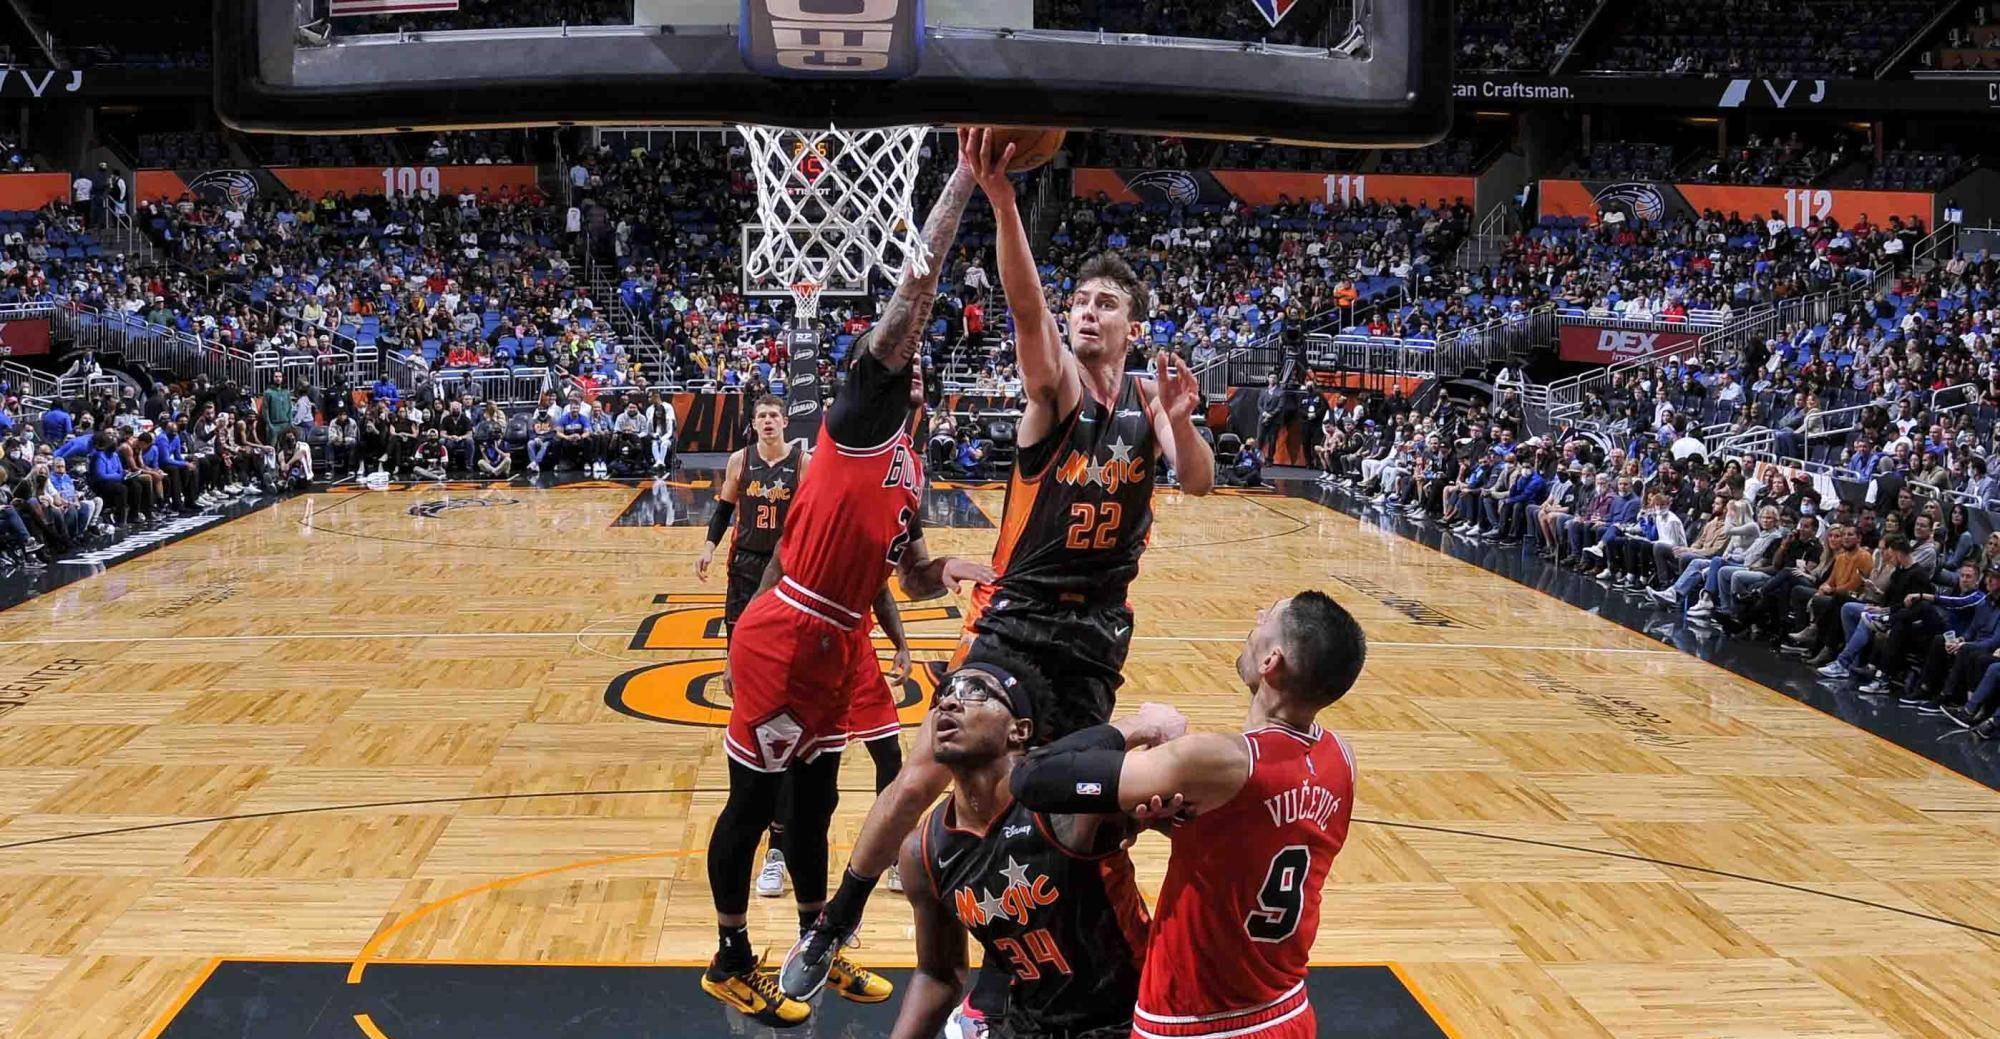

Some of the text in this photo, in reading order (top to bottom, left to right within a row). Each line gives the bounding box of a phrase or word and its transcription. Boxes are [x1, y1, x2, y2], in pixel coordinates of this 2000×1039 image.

[1482, 81, 1575, 98] Craftsman.
[382, 166, 440, 201] 109
[1323, 174, 1365, 209] 111
[1784, 189, 1832, 229] 112
[1597, 330, 1660, 354] DEX
[756, 505, 777, 529] 21
[1065, 502, 1122, 549] 22
[1264, 780, 1341, 831] VUČEVIĆ
[1002, 825, 1032, 839] Disney
[1244, 845, 1311, 944] 9
[993, 928, 1073, 980] 34
